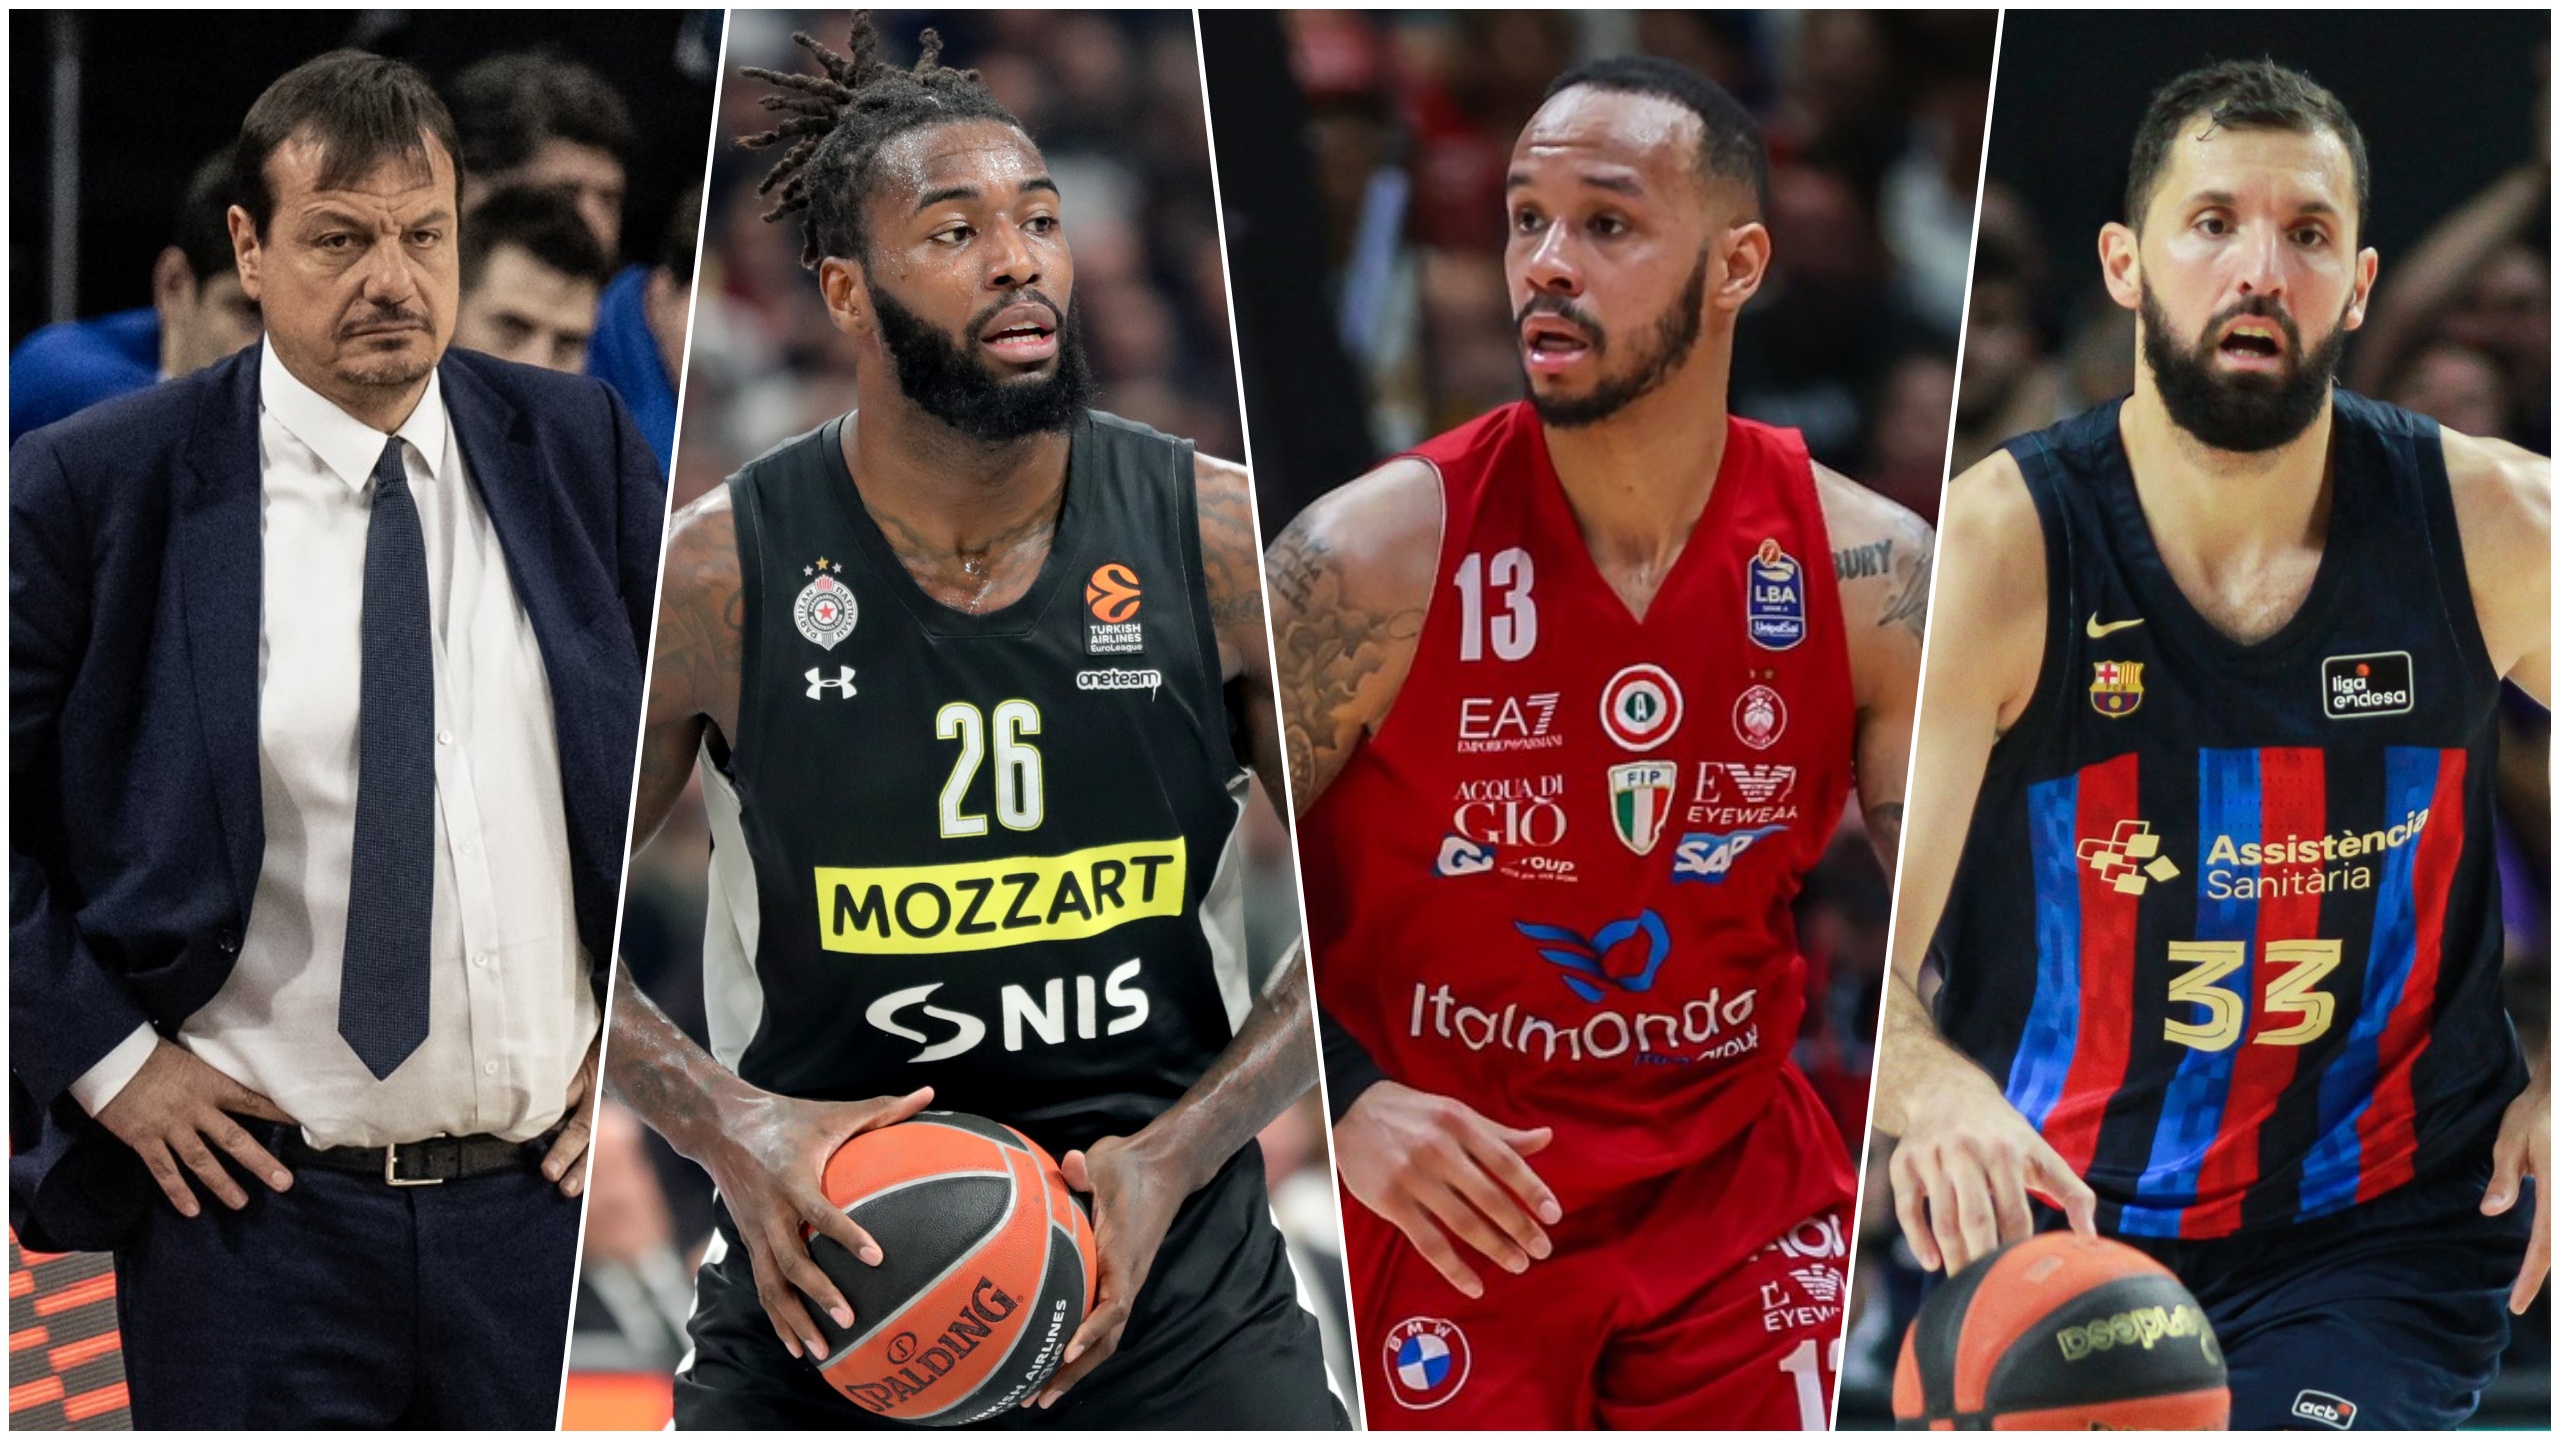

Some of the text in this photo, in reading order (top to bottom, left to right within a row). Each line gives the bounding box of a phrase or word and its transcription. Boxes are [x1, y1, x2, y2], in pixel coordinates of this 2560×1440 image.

[797, 588, 818, 639] PARTIZAN
[835, 586, 854, 638] ПАРТИЗАН
[1454, 547, 1538, 662] 13
[1755, 585, 1797, 604] LBA
[1090, 623, 1141, 634] TURKISH
[1090, 633, 1142, 644] AIRLINES
[1090, 643, 1143, 652] EuroLeague
[1077, 668, 1161, 690] oneteam
[2332, 675, 2367, 694] liga
[1459, 691, 1560, 739] EA7
[2333, 689, 2407, 709] endesa
[936, 699, 1044, 838] 26
[1453, 774, 1564, 801] ACQUA DI
[1627, 770, 1661, 787] FIP
[1673, 835, 1755, 875] SAP
[2206, 808, 2430, 866] Assistència
[1519, 856, 1576, 874] oup
[2206, 861, 2371, 900] Sanitària
[832, 854, 1175, 939] MOZZART
[1001, 957, 1150, 1053] NIS
[2163, 938, 2343, 1052] 33
[1389, 1321, 1453, 1353] BMW
[1763, 1306, 1841, 1333] EYEW
[844, 1276, 1018, 1412] SPALDING
[957, 1299, 1067, 1425] RKISH AIRLINES
[1778, 1339, 1842, 1431] 1
[2299, 1401, 2339, 1421] acb
